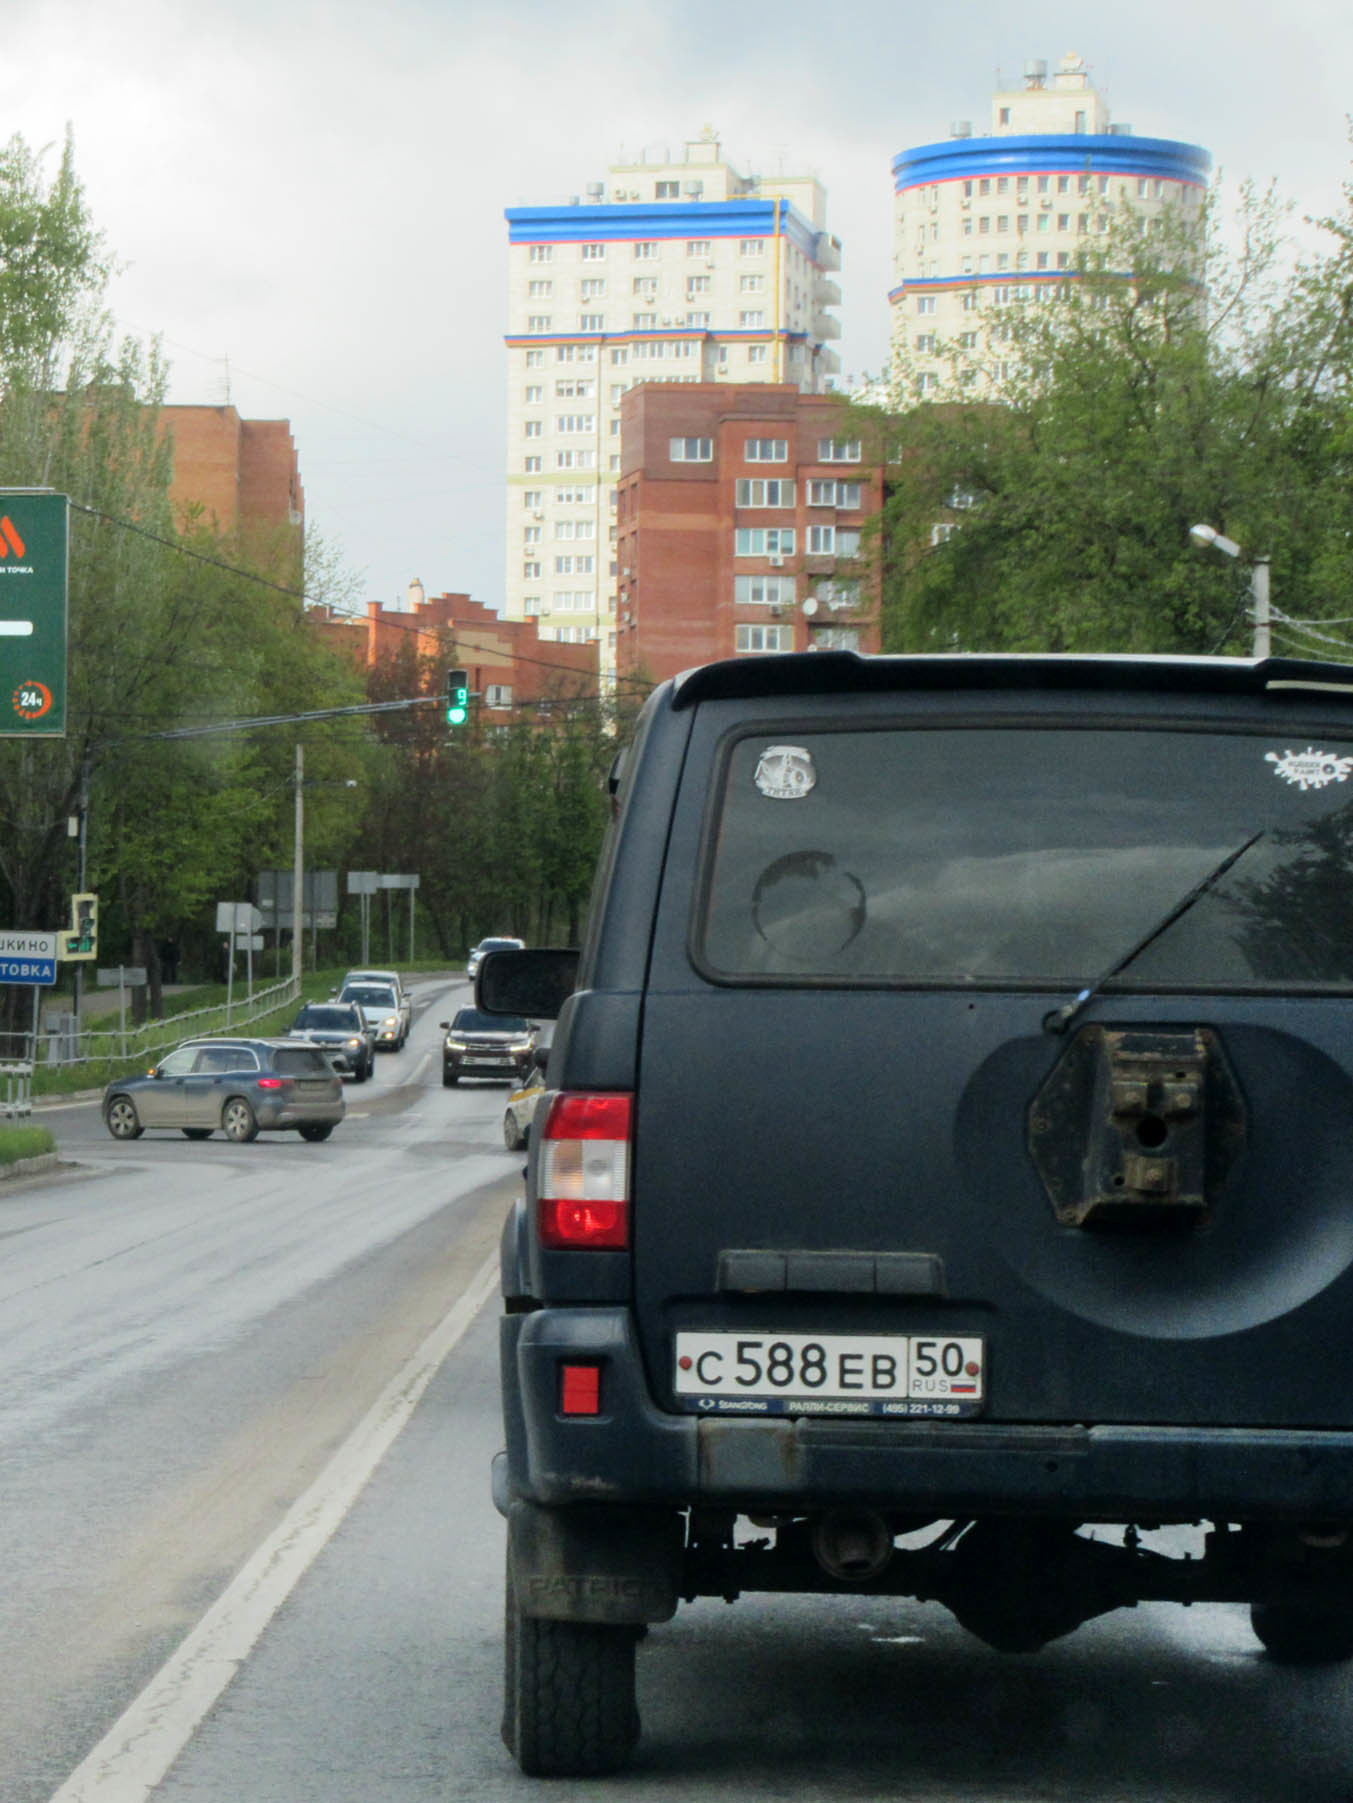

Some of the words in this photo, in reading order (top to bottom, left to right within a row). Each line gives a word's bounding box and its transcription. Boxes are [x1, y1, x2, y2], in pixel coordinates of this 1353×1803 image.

[7, 566, 34, 574] ТОЧКА
[457, 688, 467, 706] 9
[915, 1342, 964, 1377] 50
[912, 1379, 948, 1393] RUS
[789, 1401, 870, 1413] РАЛЛИ-СЕРВИС
[529, 1576, 655, 1596] PATRIO
